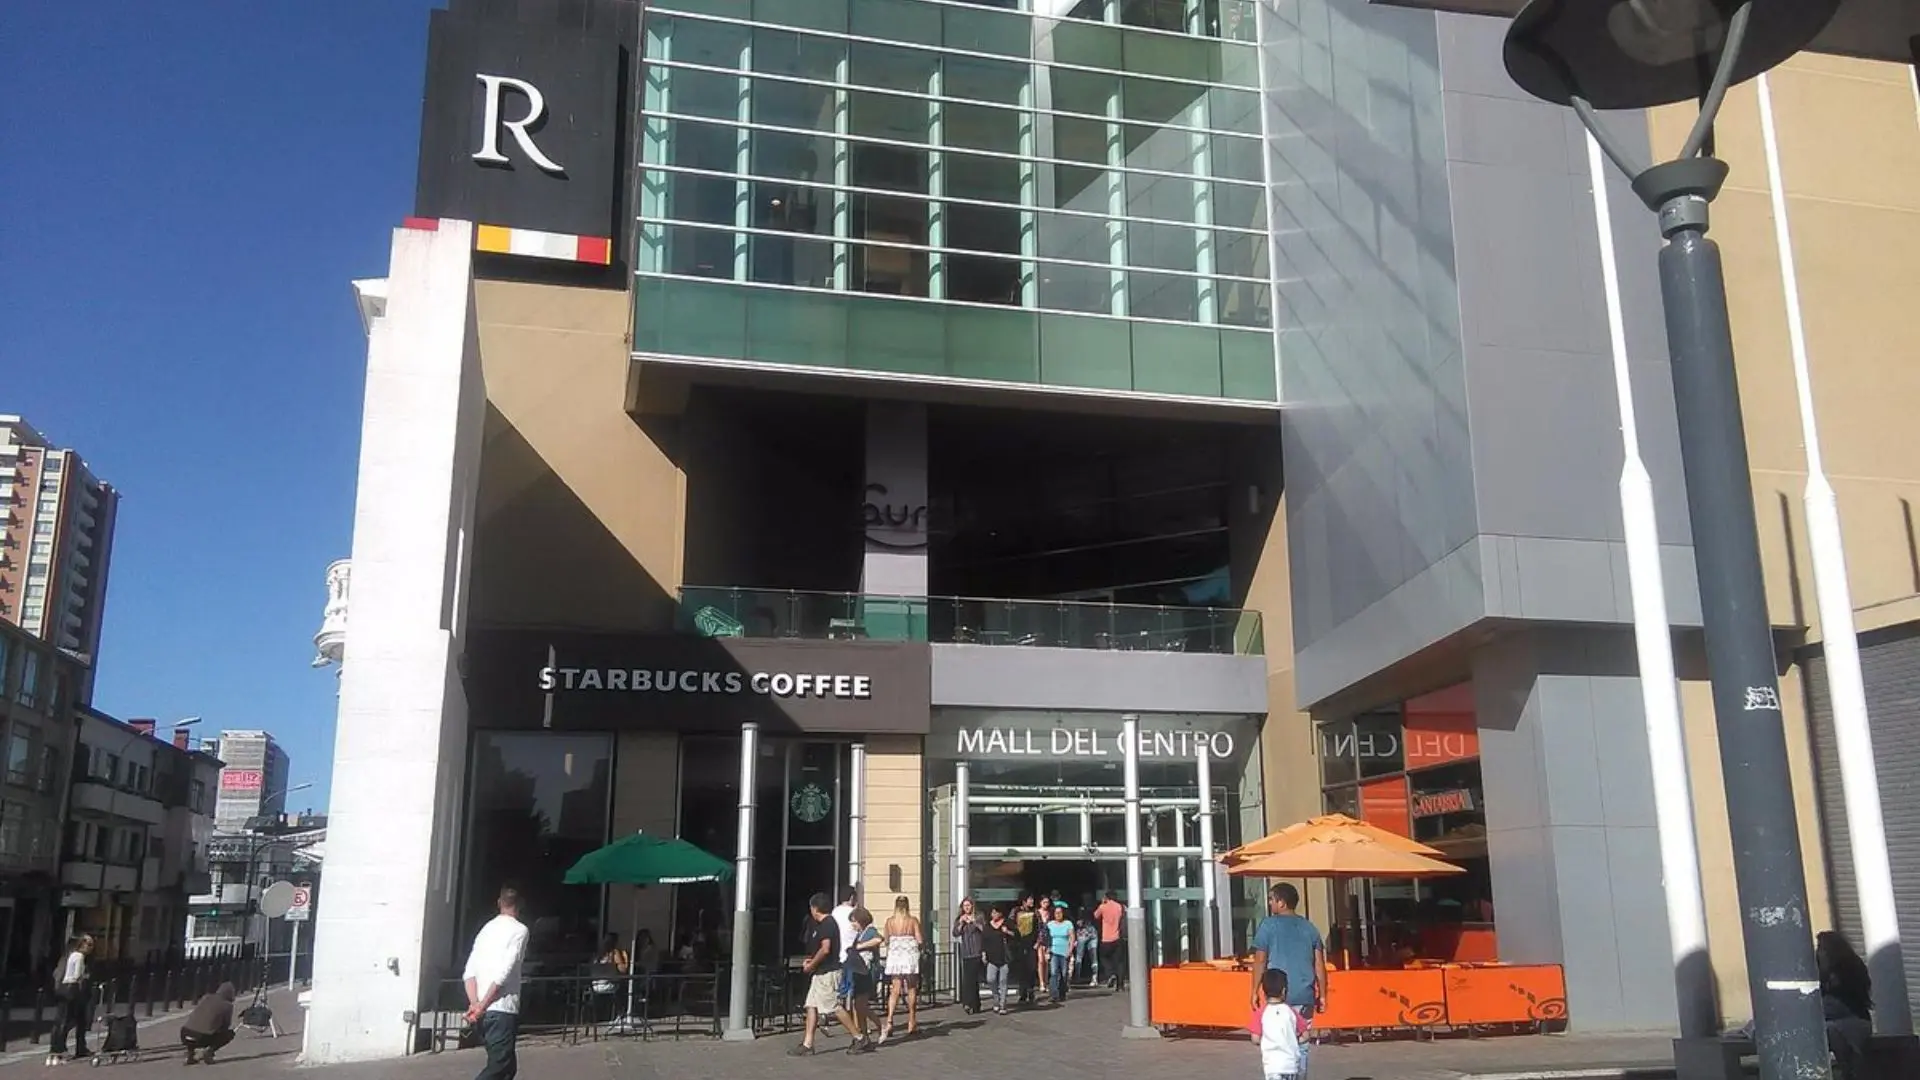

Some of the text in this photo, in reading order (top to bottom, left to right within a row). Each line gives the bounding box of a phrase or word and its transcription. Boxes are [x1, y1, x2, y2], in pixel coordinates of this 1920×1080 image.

[472, 73, 564, 171] R
[538, 667, 872, 697] STARBUCKS COFFEE
[957, 727, 1042, 754] MALL
[1051, 728, 1107, 755] DEL
